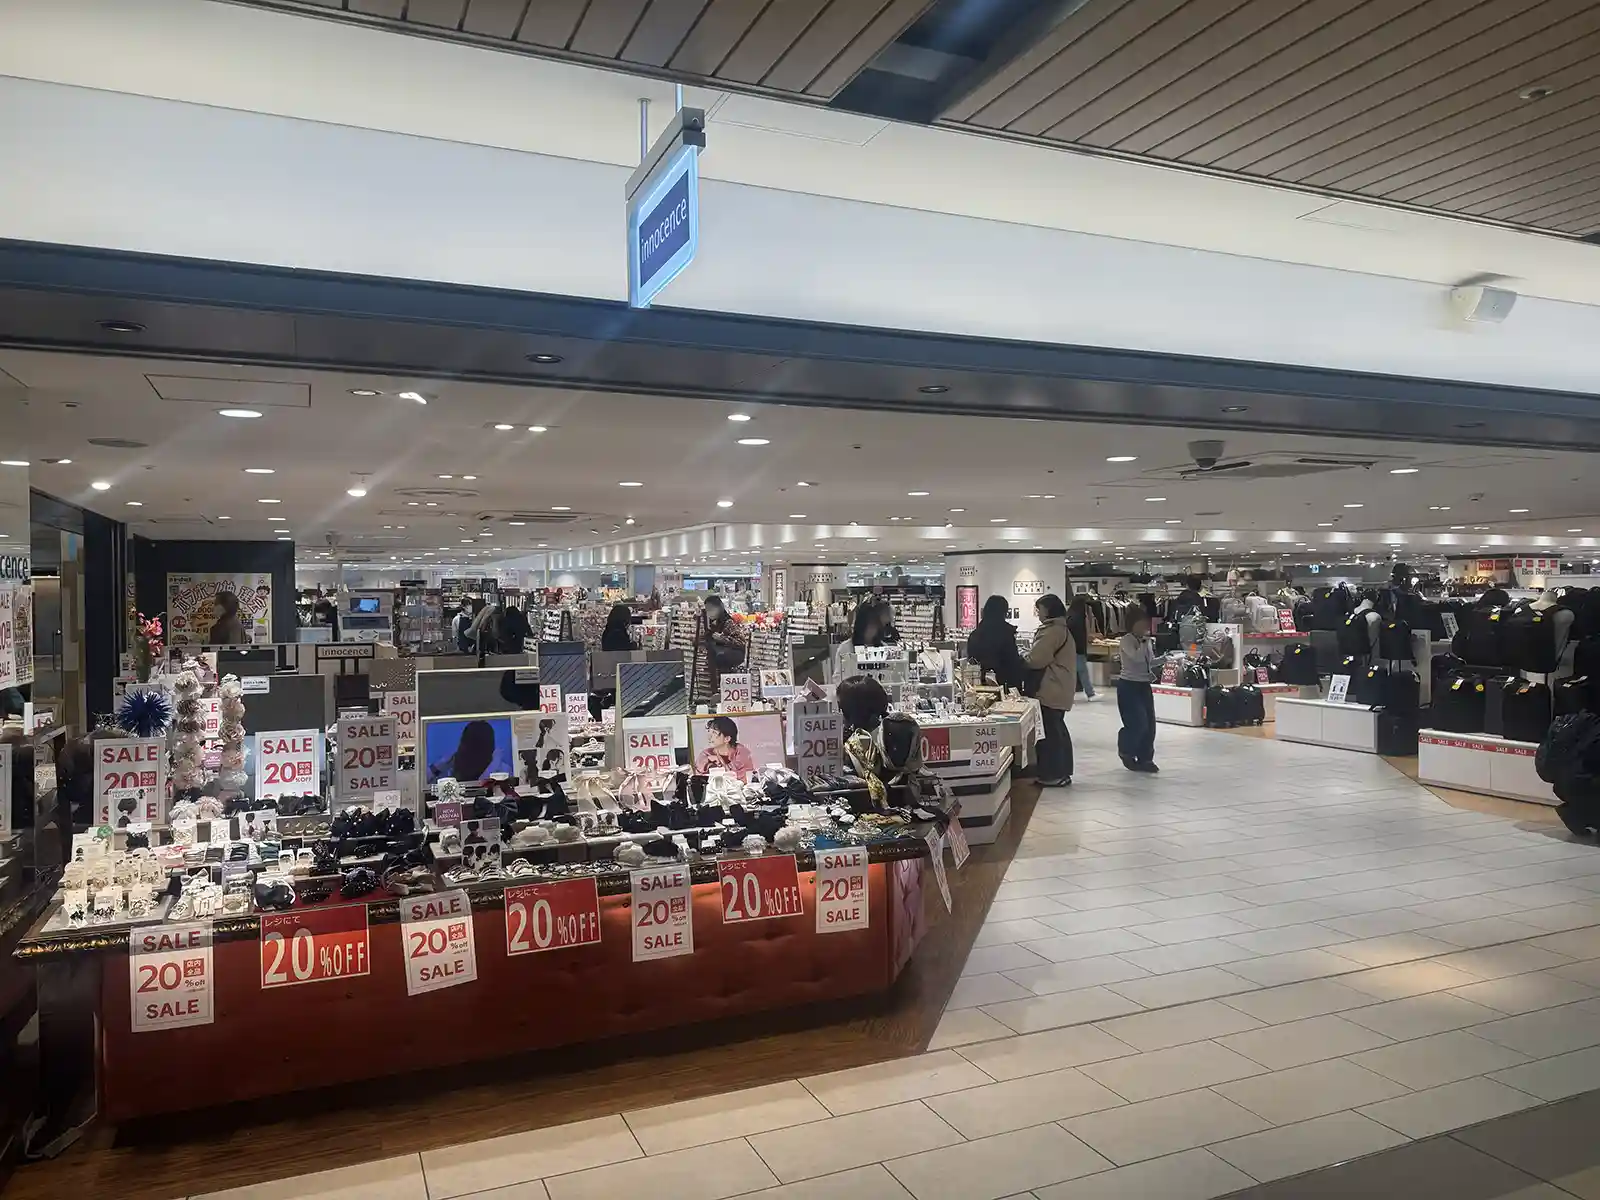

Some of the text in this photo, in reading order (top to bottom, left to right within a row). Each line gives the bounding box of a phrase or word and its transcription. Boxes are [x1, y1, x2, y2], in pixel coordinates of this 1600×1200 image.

[641, 198, 686, 264] innocence
[322, 648, 369, 656] innocence
[392, 695, 416, 705] SAL
[540, 689, 557, 698] ALE
[724, 690, 740, 701] 20
[568, 705, 580, 713] 20
[726, 705, 747, 713] SALE
[348, 724, 390, 739] SALE
[804, 720, 837, 732] SALE
[975, 728, 996, 736] SALE
[263, 738, 313, 755] SALE
[630, 734, 669, 748] SALE
[803, 740, 826, 757] 20
[973, 741, 989, 754] 20
[102, 746, 158, 763] SALE
[344, 747, 376, 769] 20
[264, 763, 297, 785] 20
[807, 764, 836, 776] SALE
[103, 771, 139, 796] 20
[350, 776, 389, 790] SALE
[102, 803, 157, 822] SE
[720, 862, 747, 872] レジにて
[824, 853, 862, 869] SALE
[641, 874, 683, 892] SALE
[821, 878, 849, 902] 20
[508, 888, 540, 899] レジにて
[722, 873, 799, 919] 20 %OFF
[411, 898, 462, 920] SALE
[637, 900, 669, 927] 20
[826, 908, 860, 923] SALE
[265, 916, 301, 927] レジにて
[509, 899, 595, 951] 20 %OFF
[143, 931, 201, 952] SALE
[410, 928, 448, 959] 20
[644, 932, 682, 950] SALE
[265, 928, 364, 984] 20 %OFF
[137, 962, 182, 993] 20
[420, 960, 464, 981] SALE
[146, 999, 199, 1019] SALE
